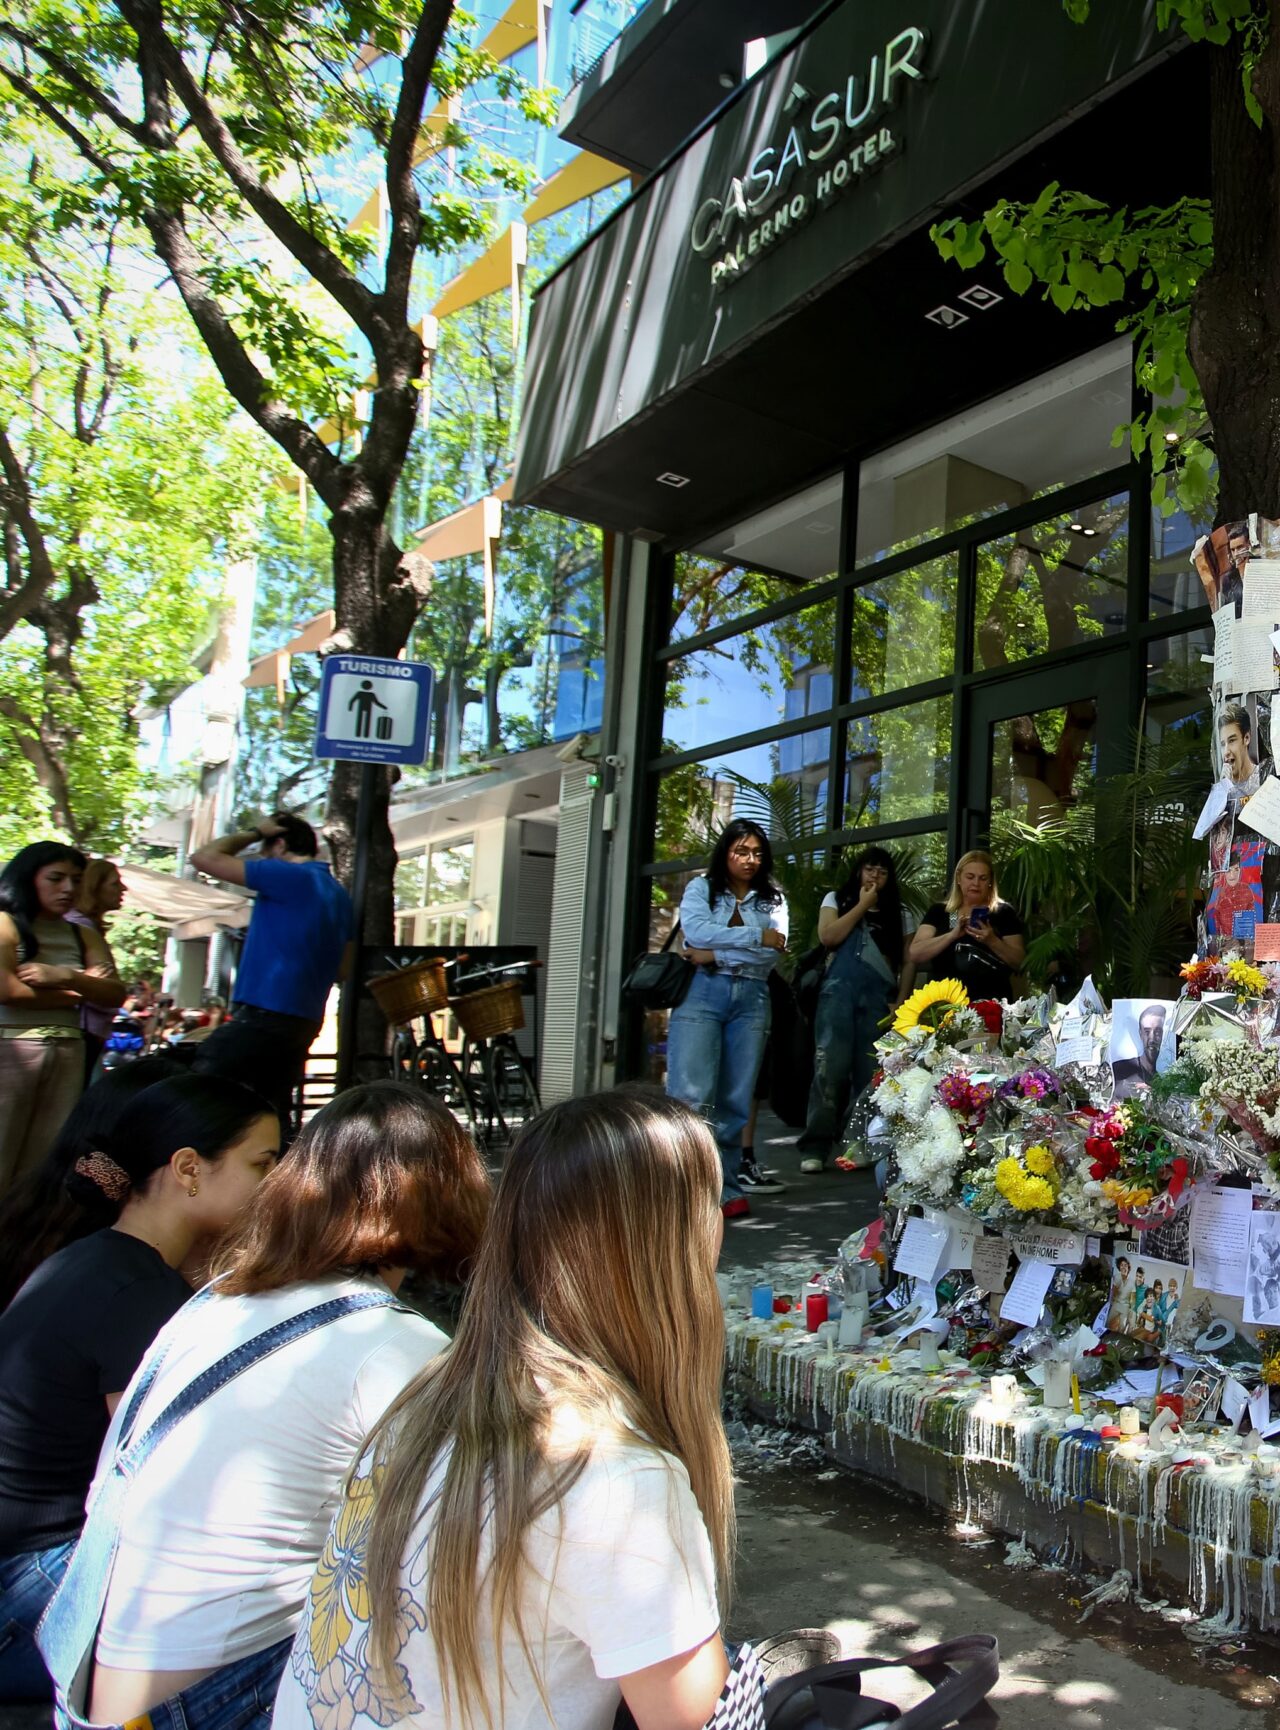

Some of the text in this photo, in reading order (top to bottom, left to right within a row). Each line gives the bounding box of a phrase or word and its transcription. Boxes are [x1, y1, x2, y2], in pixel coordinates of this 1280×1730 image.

[711, 128, 898, 286] PALERMO HOTEL
[339, 660, 413, 678] TURISMO
[1042, 1235, 1076, 1250] HEARTS
